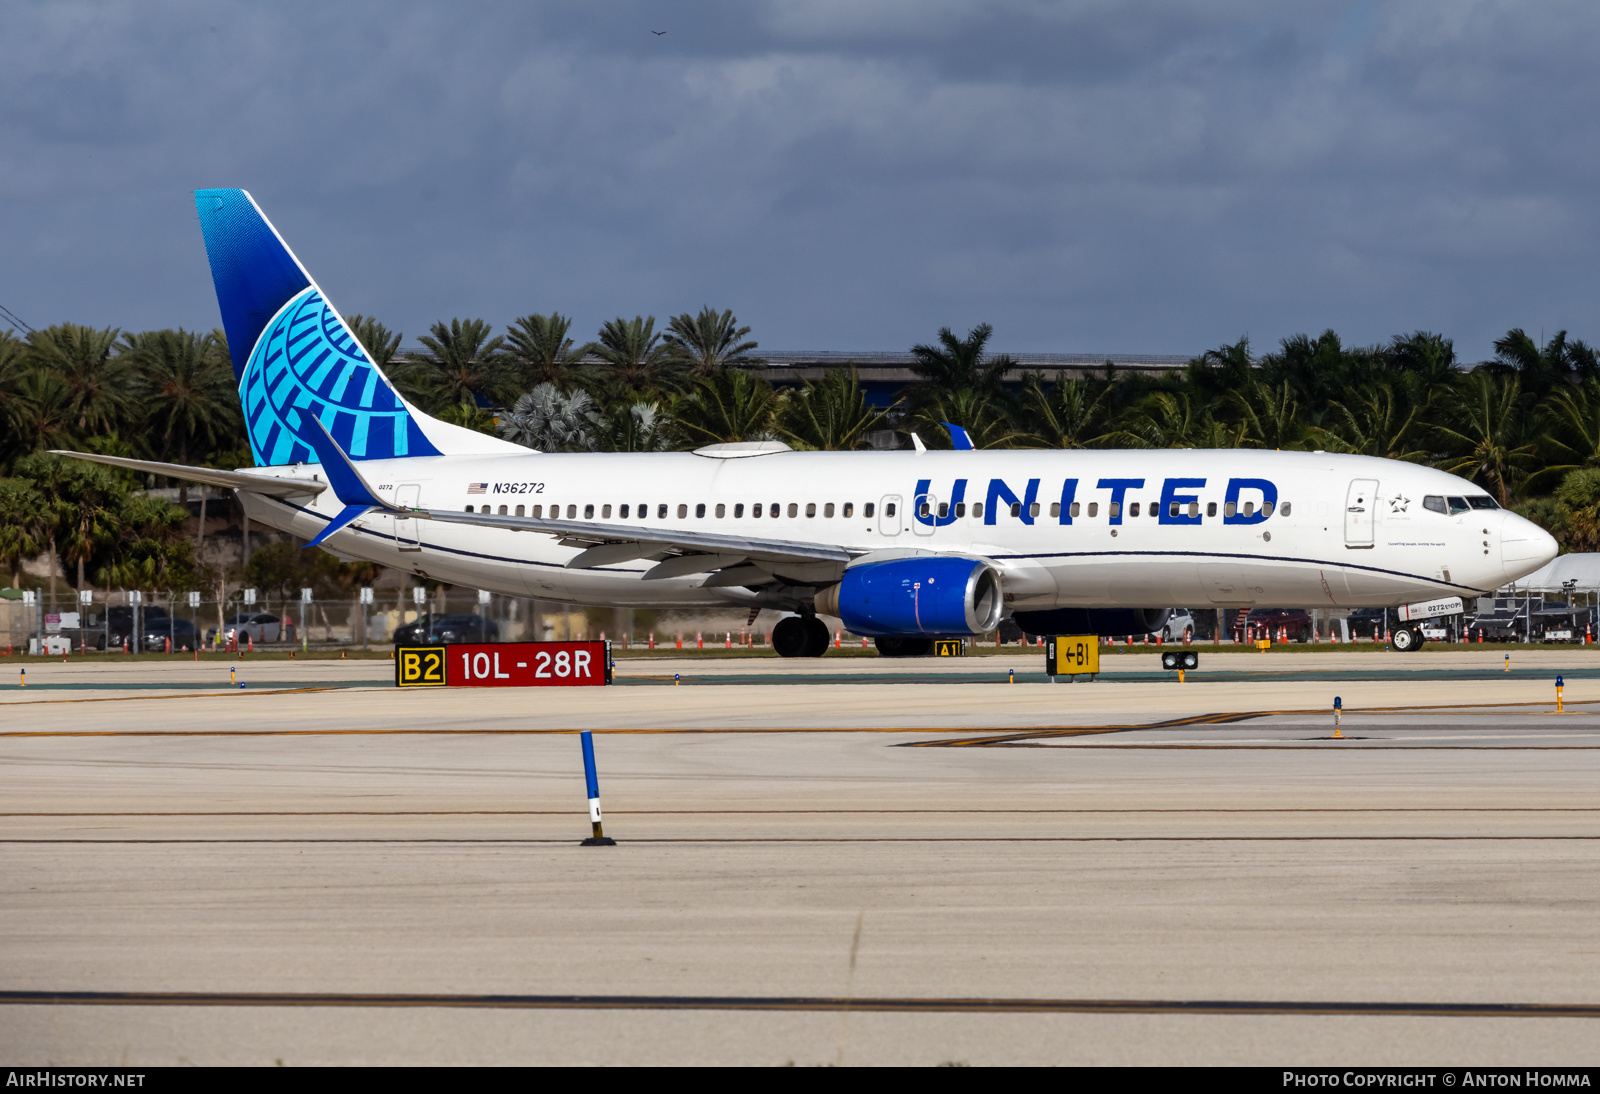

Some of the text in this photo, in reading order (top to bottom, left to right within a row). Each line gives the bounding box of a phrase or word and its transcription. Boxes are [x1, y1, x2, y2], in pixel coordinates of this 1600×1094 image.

[492, 482, 545, 494] N36272
[913, 478, 1279, 527] UNITED
[940, 643, 956, 656] A1
[1077, 643, 1089, 666] B1
[404, 653, 441, 680] B2
[462, 652, 510, 680] 10L
[535, 650, 592, 678] 28R
